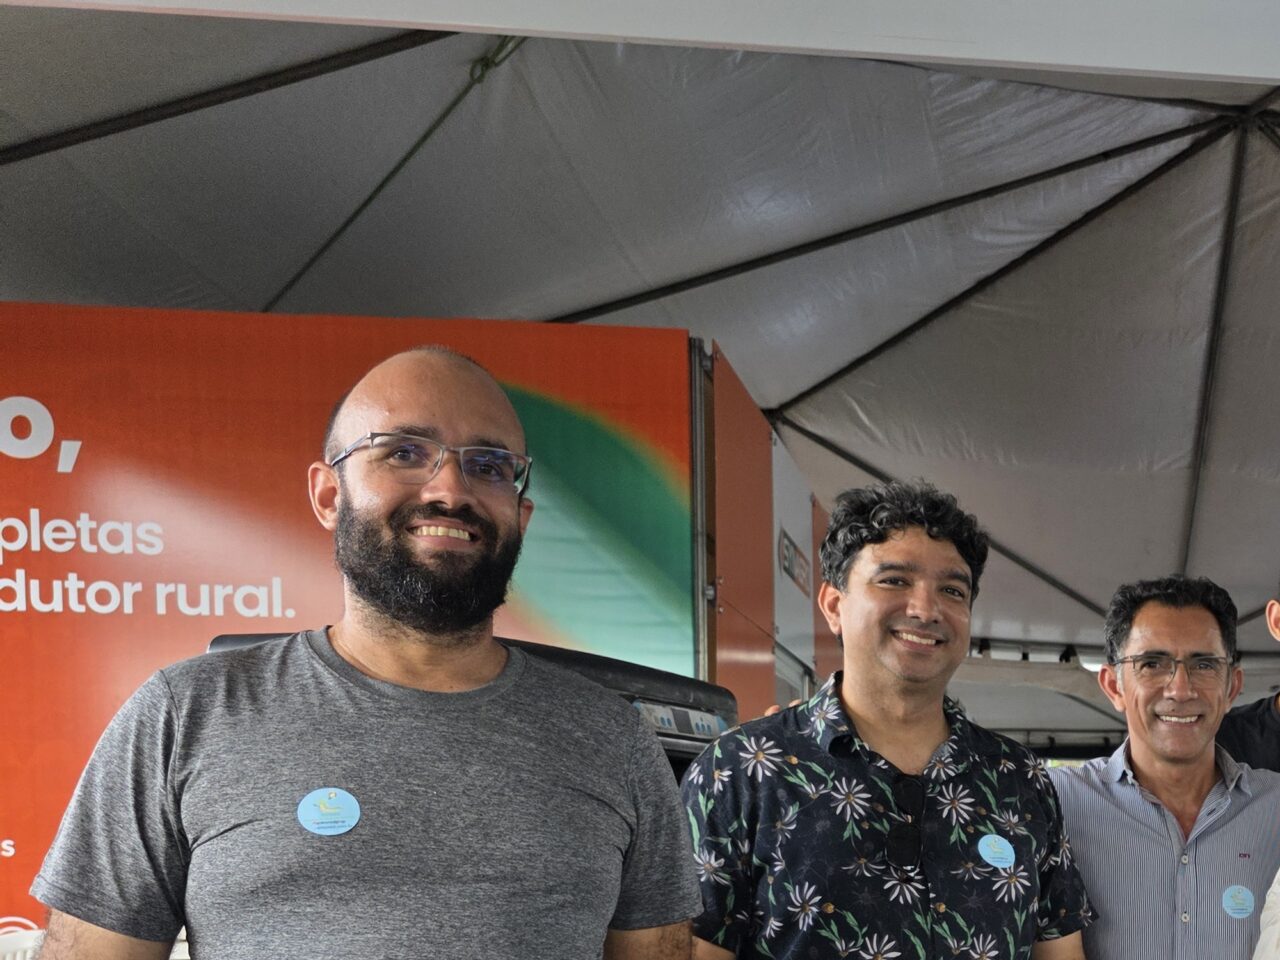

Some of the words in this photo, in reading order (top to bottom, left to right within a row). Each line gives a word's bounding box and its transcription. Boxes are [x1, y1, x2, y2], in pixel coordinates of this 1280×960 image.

[0, 508, 164, 566] pletas
[0, 568, 142, 615] dutor
[156, 576, 296, 618] rural.
